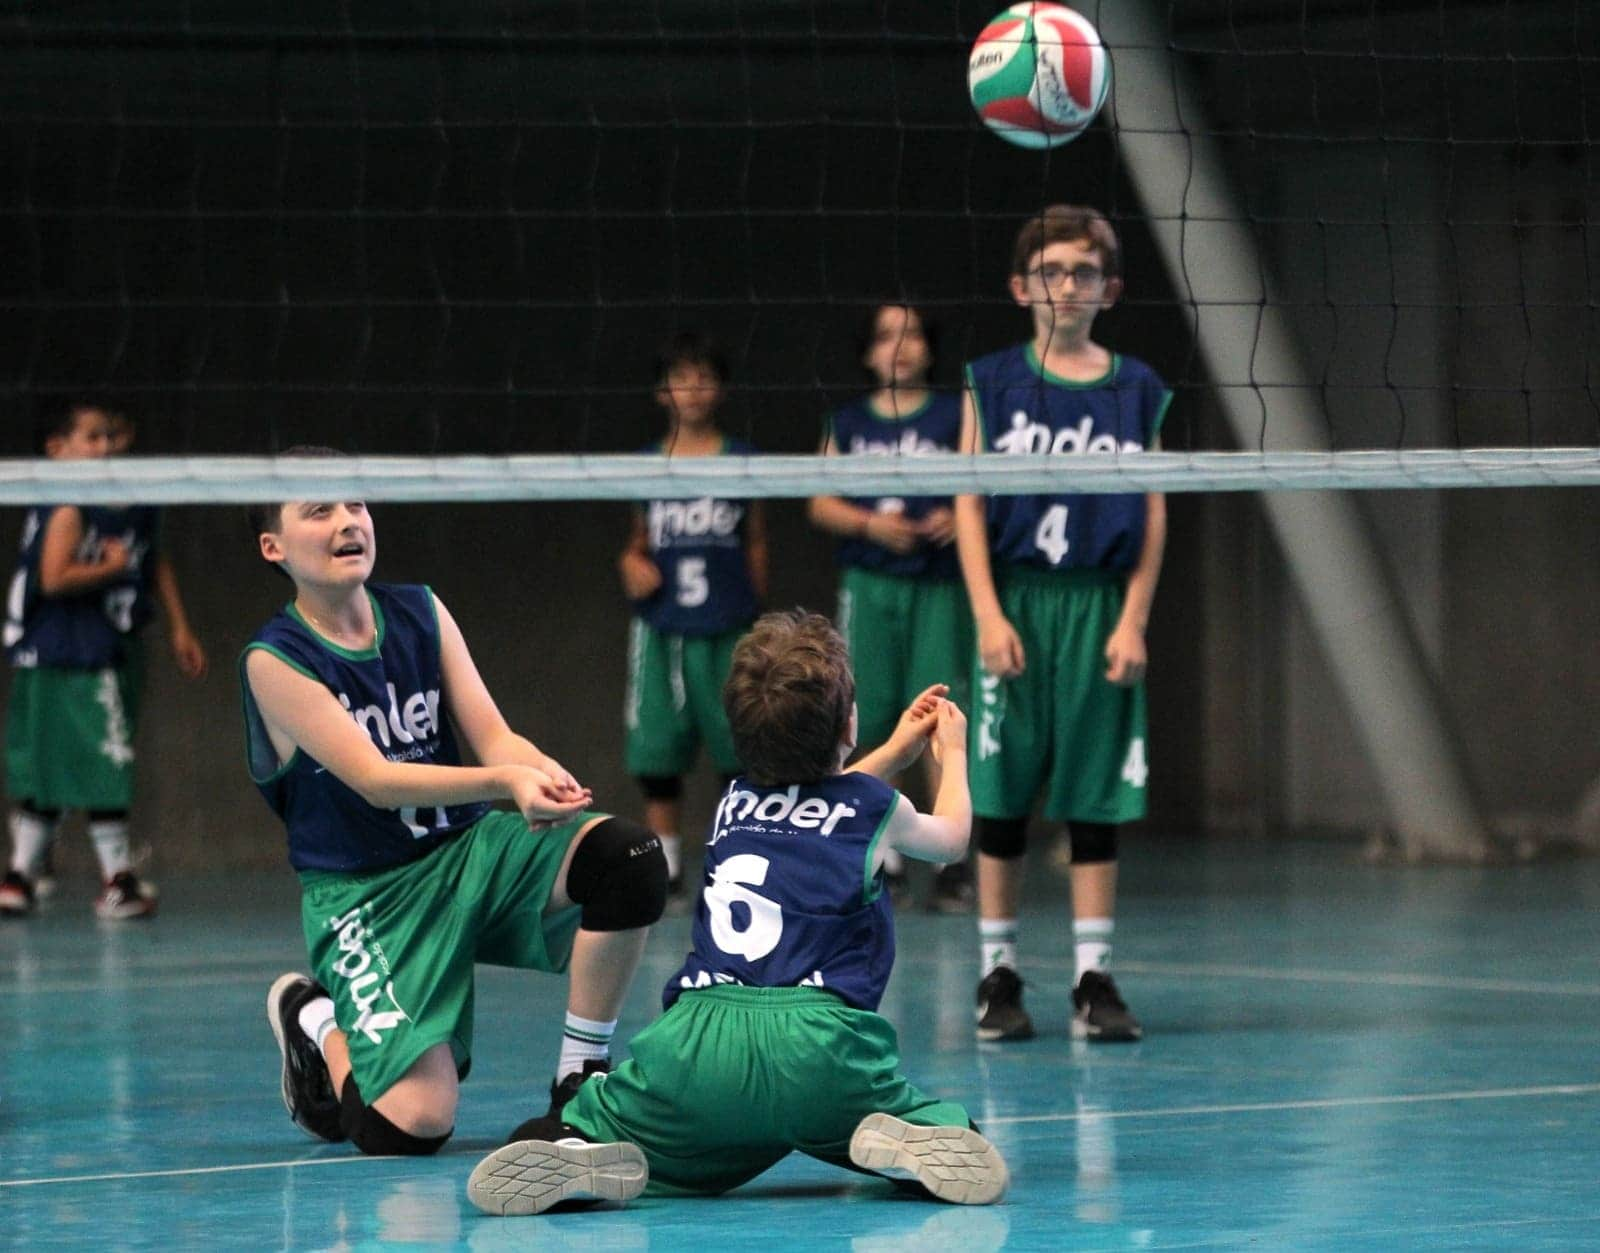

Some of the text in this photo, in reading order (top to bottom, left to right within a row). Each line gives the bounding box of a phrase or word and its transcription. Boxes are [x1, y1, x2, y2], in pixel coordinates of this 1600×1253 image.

[1036, 504, 1069, 565] 4
[677, 556, 709, 607] 5
[338, 682, 440, 748] nder
[1121, 737, 1148, 788] 4
[703, 854, 784, 962] 6
